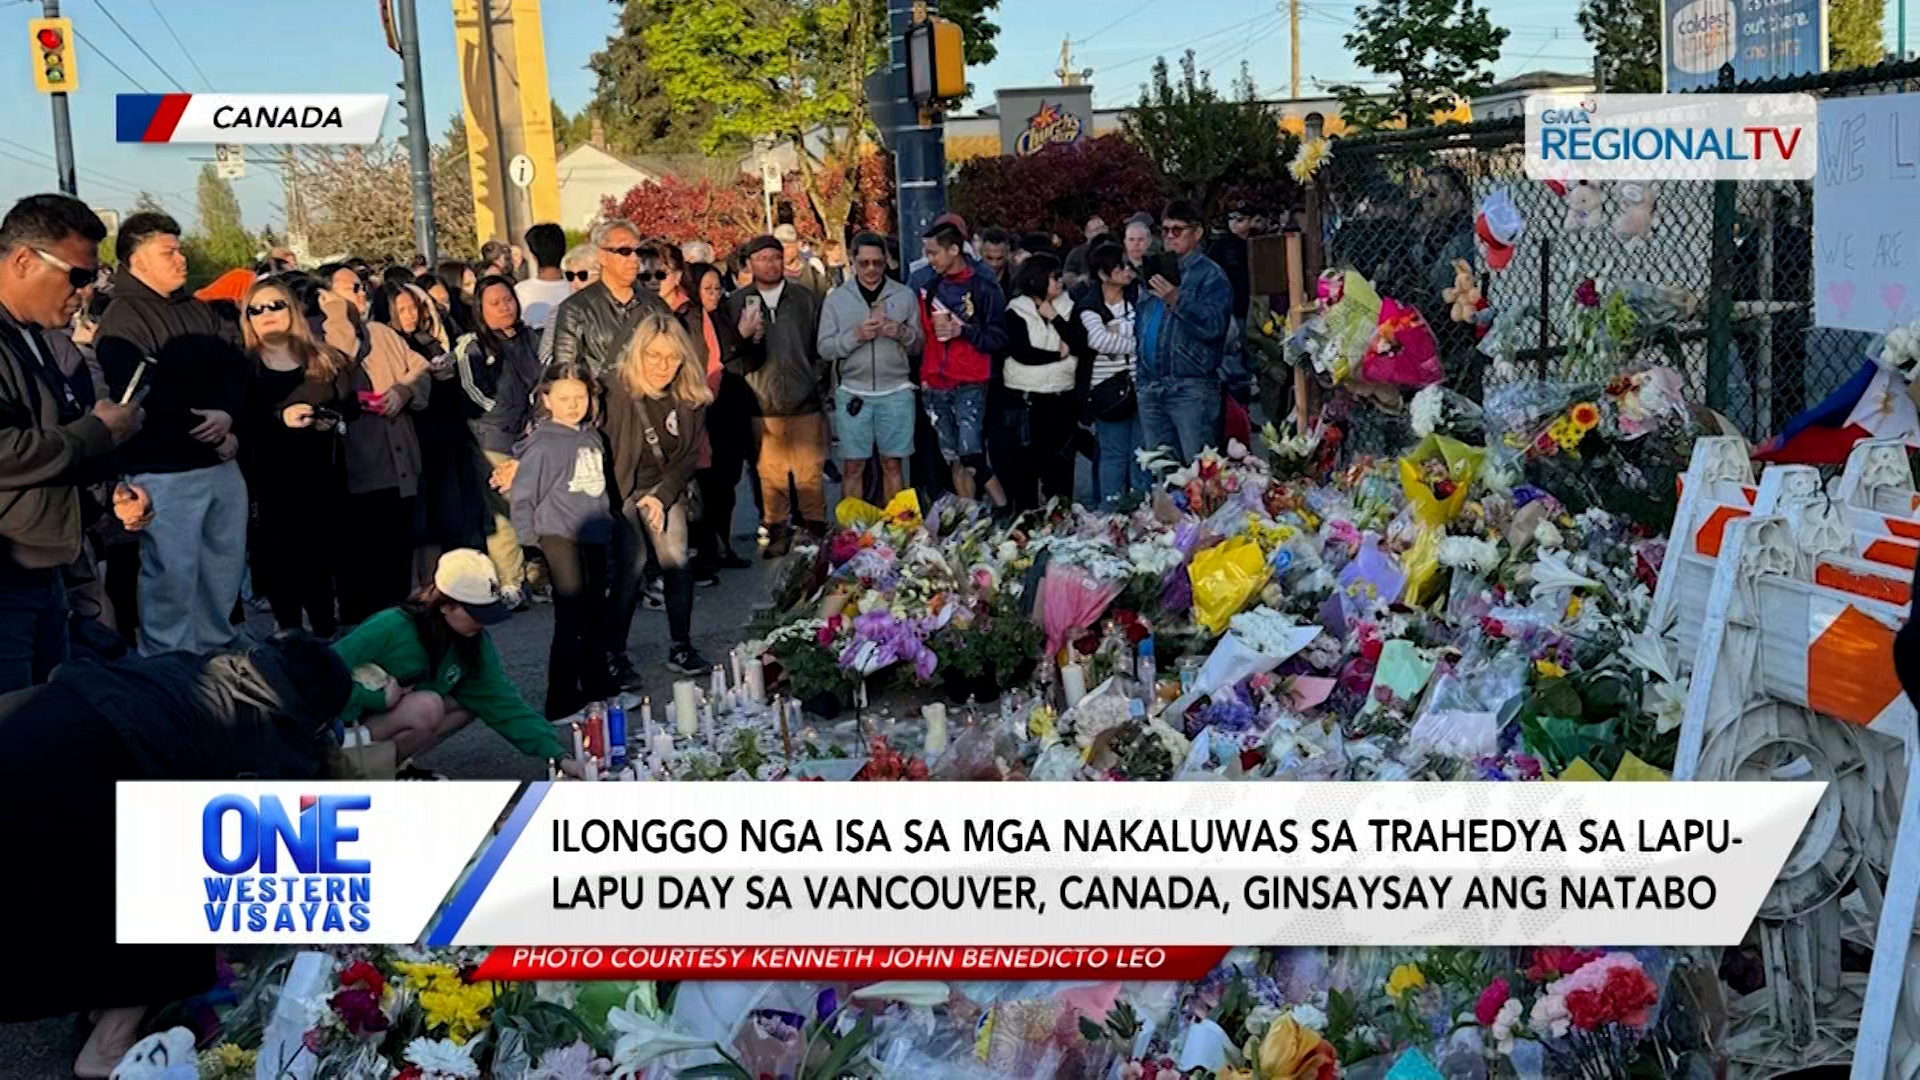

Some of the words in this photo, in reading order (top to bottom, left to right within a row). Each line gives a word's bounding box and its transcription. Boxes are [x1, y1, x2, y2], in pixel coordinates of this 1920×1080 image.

[1820, 112, 1867, 187] WE
[1889, 111, 1918, 180] L
[1820, 231, 1855, 270] WE
[1873, 231, 1902, 268] ARE
